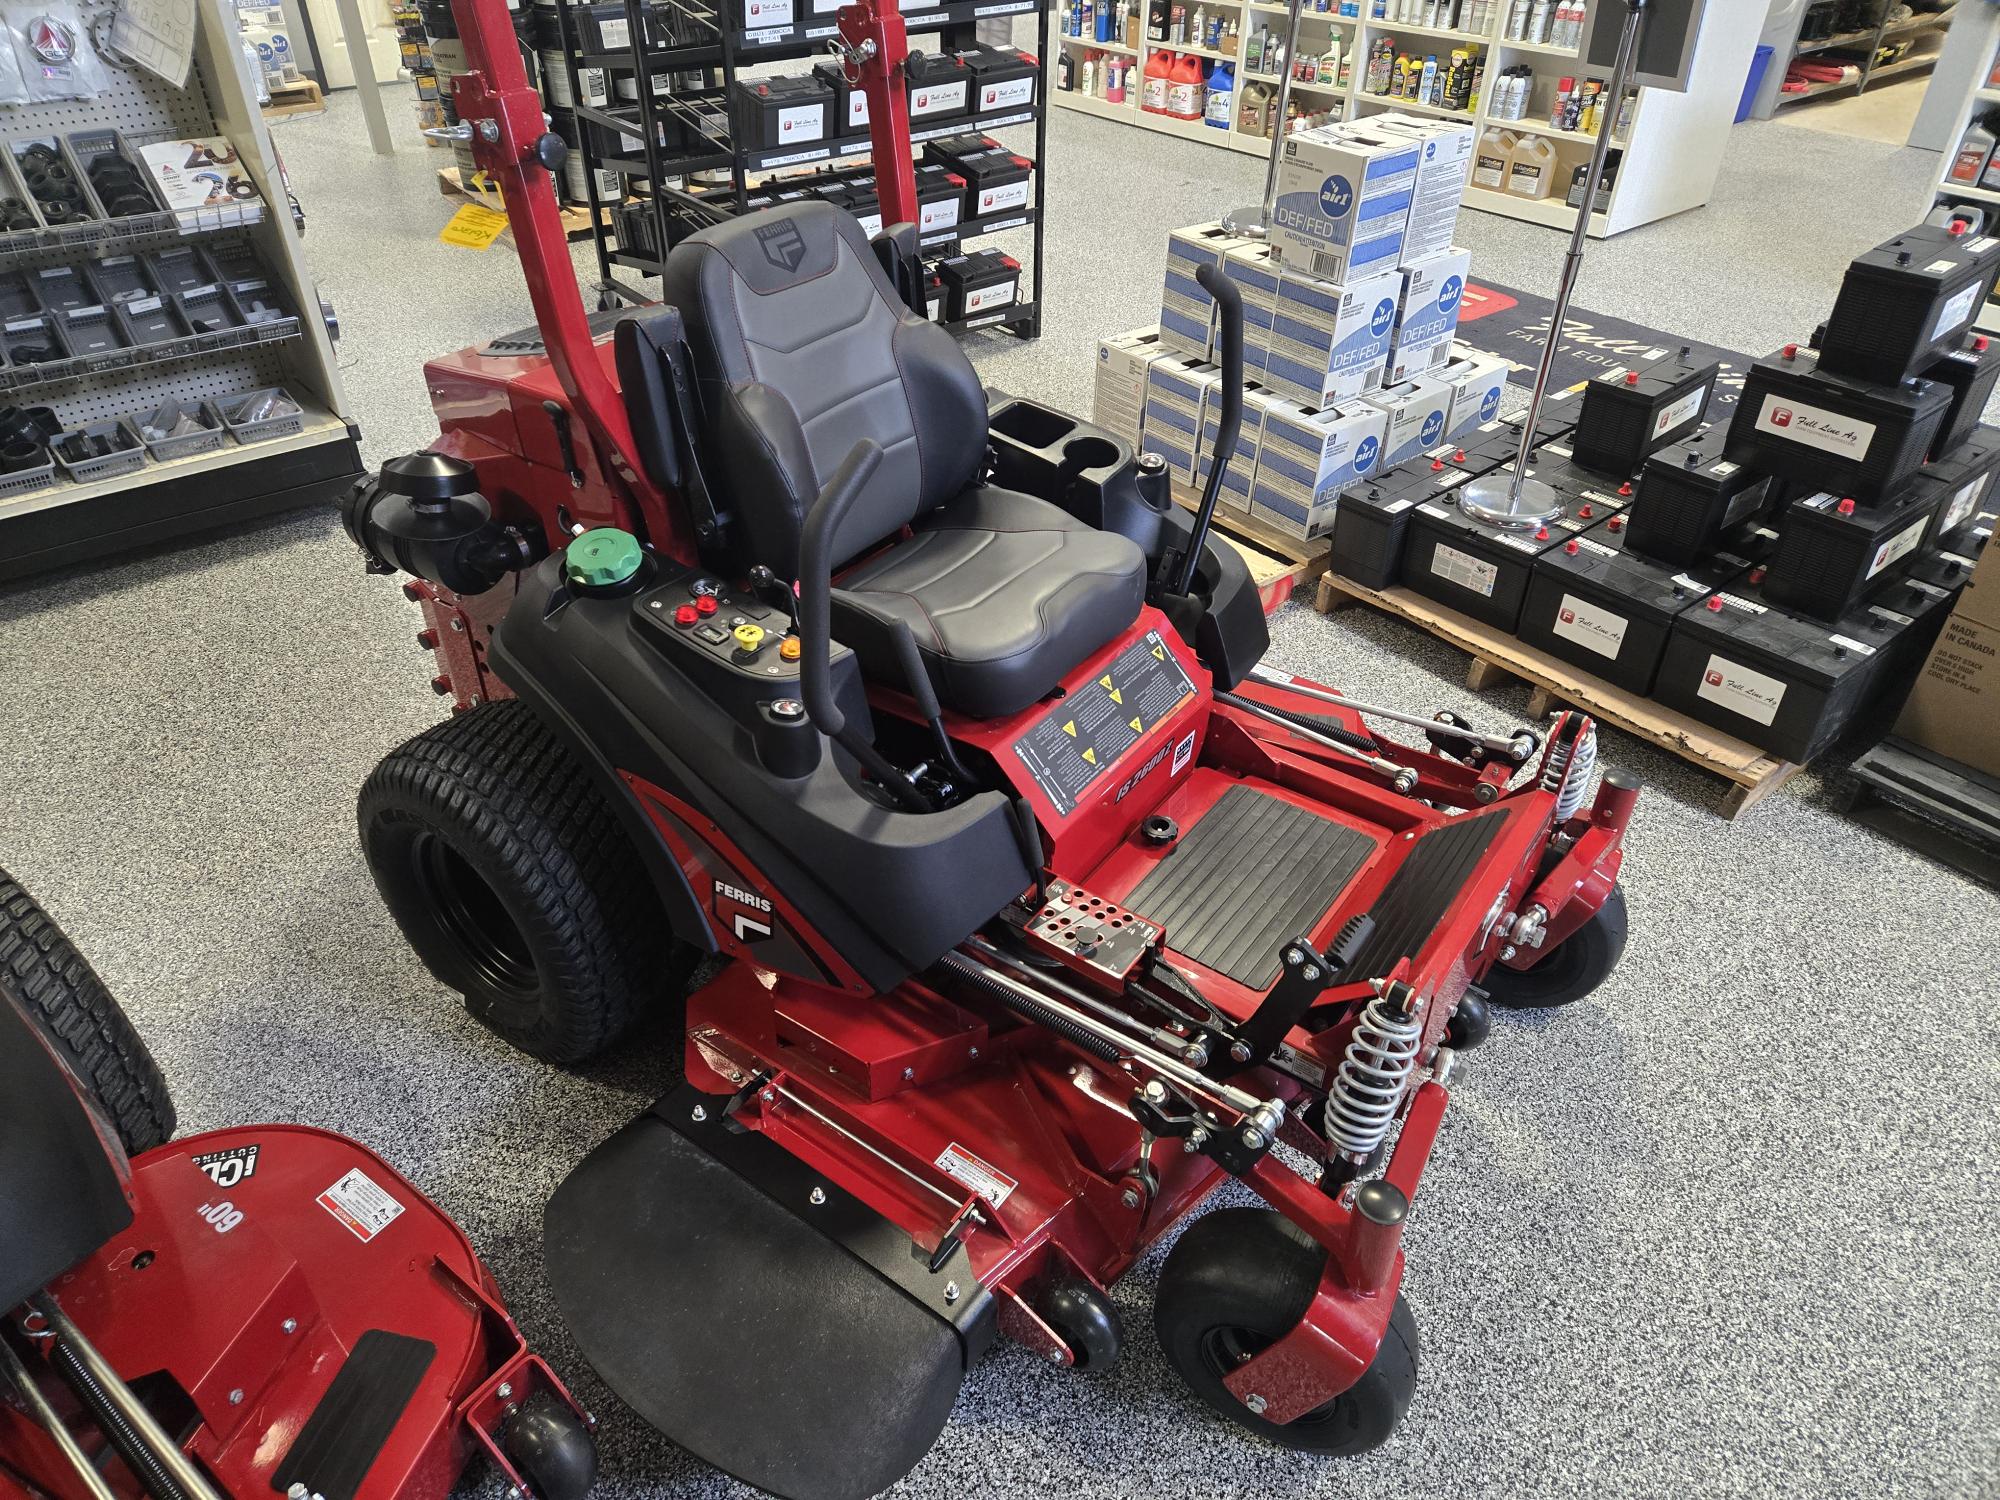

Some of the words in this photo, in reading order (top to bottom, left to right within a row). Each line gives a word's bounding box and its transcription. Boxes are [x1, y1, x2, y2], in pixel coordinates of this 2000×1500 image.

[930, 94, 940, 102] Full
[1008, 88, 1020, 96] Line
[1155, 87, 1161, 96] 2
[1181, 92, 1188, 102] 2
[1016, 190, 1022, 198] Ag
[1321, 190, 1348, 206] air1
[758, 220, 793, 238] FERRIS
[1278, 208, 1334, 238] DEF/FED
[1440, 288, 1460, 302] air1
[1373, 308, 1391, 326] air1
[1403, 318, 1448, 344] DEF/FED
[1334, 342, 1380, 369] DEF/FED
[1481, 397, 1500, 412] air1
[1672, 410, 1680, 418] Full
[1680, 404, 1690, 414] Line
[1421, 421, 1442, 436] air1
[1797, 416, 1818, 428] Full
[1818, 424, 1840, 436] Line
[1841, 432, 1857, 442] Ag
[1356, 446, 1376, 462] air1
[1578, 616, 1593, 628] Full
[1594, 623, 1609, 634] Line
[1609, 630, 1621, 640] Ag
[1950, 624, 1978, 638] MADE
[1945, 632, 1956, 642] IN
[1958, 637, 1996, 656] CANADA
[1931, 662, 1952, 674] STORE
[1934, 656, 1951, 666] OVER
[1958, 664, 1975, 676] HIGH
[1948, 653, 1962, 663] NOT
[1962, 658, 1984, 671] STACK
[1927, 670, 1944, 681] COOL
[1945, 676, 1959, 686] DRY
[1959, 682, 1982, 694] PLACE
[1727, 680, 1744, 690] Full
[1745, 688, 1763, 699] Line
[1764, 698, 1776, 706] Ag
[1115, 786, 1129, 804] IS
[715, 880, 772, 912] FERRIS
[973, 1160, 996, 1176] DANGER
